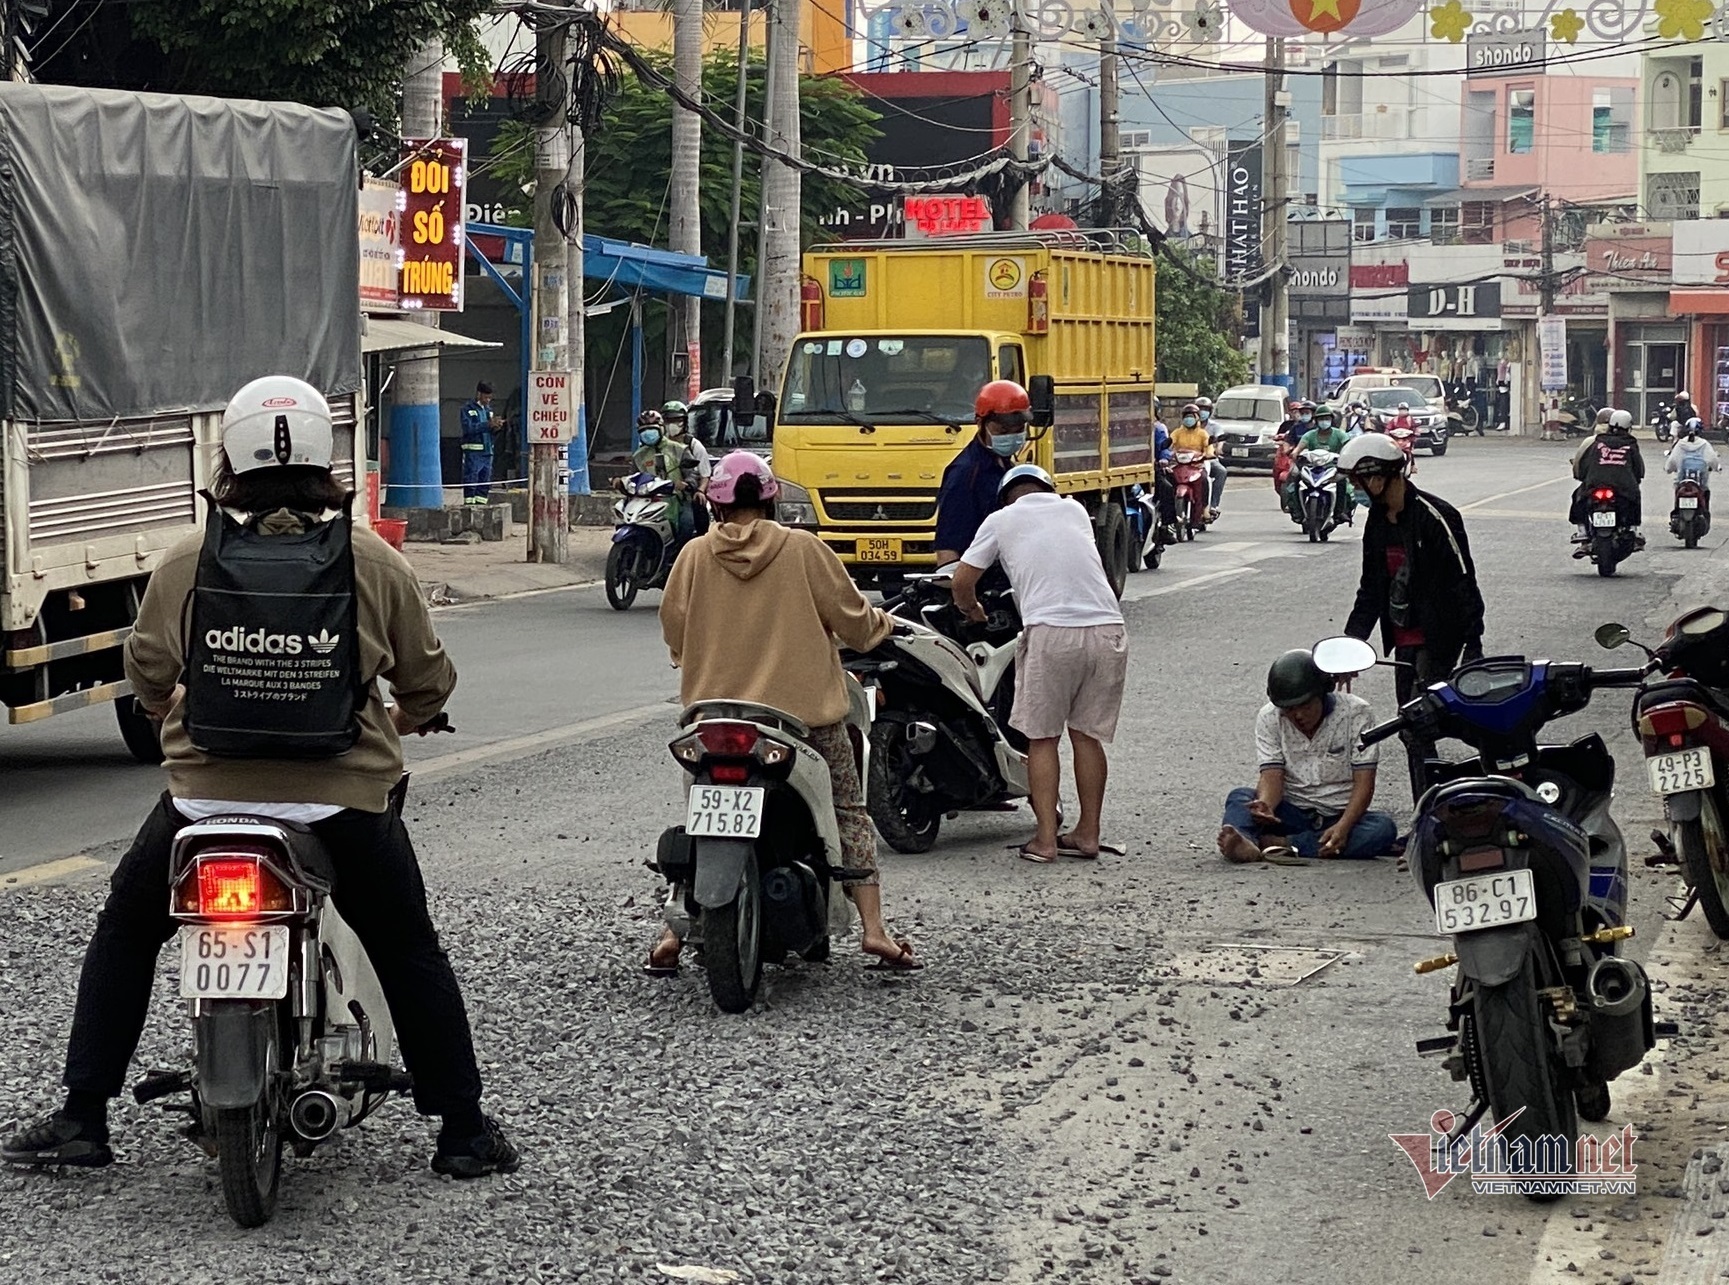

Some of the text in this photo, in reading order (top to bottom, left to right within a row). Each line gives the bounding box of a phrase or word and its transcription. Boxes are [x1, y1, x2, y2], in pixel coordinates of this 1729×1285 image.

[1475, 43, 1532, 66] shondo
[905, 197, 990, 220] HOTEL
[412, 200, 445, 244] SỐ
[402, 255, 454, 295] TRÚNG
[1289, 265, 1339, 287] hondo
[1428, 285, 1475, 316] D-H
[542, 391, 559, 405] VÉ
[860, 550, 898, 561] 034.59
[868, 539, 889, 550] 50H
[205, 626, 303, 655] adidas
[203, 664, 340, 679] DIE WELTMARKE MIT DEN 3 STREIFEN
[212, 654, 332, 668] THE BRAND WITH THE 3 STRIPES
[221, 677, 322, 690] LA MARQUE AUX 3 BANDES
[1657, 751, 1702, 774] 49-P3
[1658, 768, 1705, 792] 2225
[701, 789, 753, 812] 59-X2
[206, 817, 260, 825] HONDA
[691, 812, 756, 834] 715.82
[1445, 896, 1528, 929] 532.97
[199, 931, 271, 959] 65-S1
[196, 963, 271, 992] 0077
